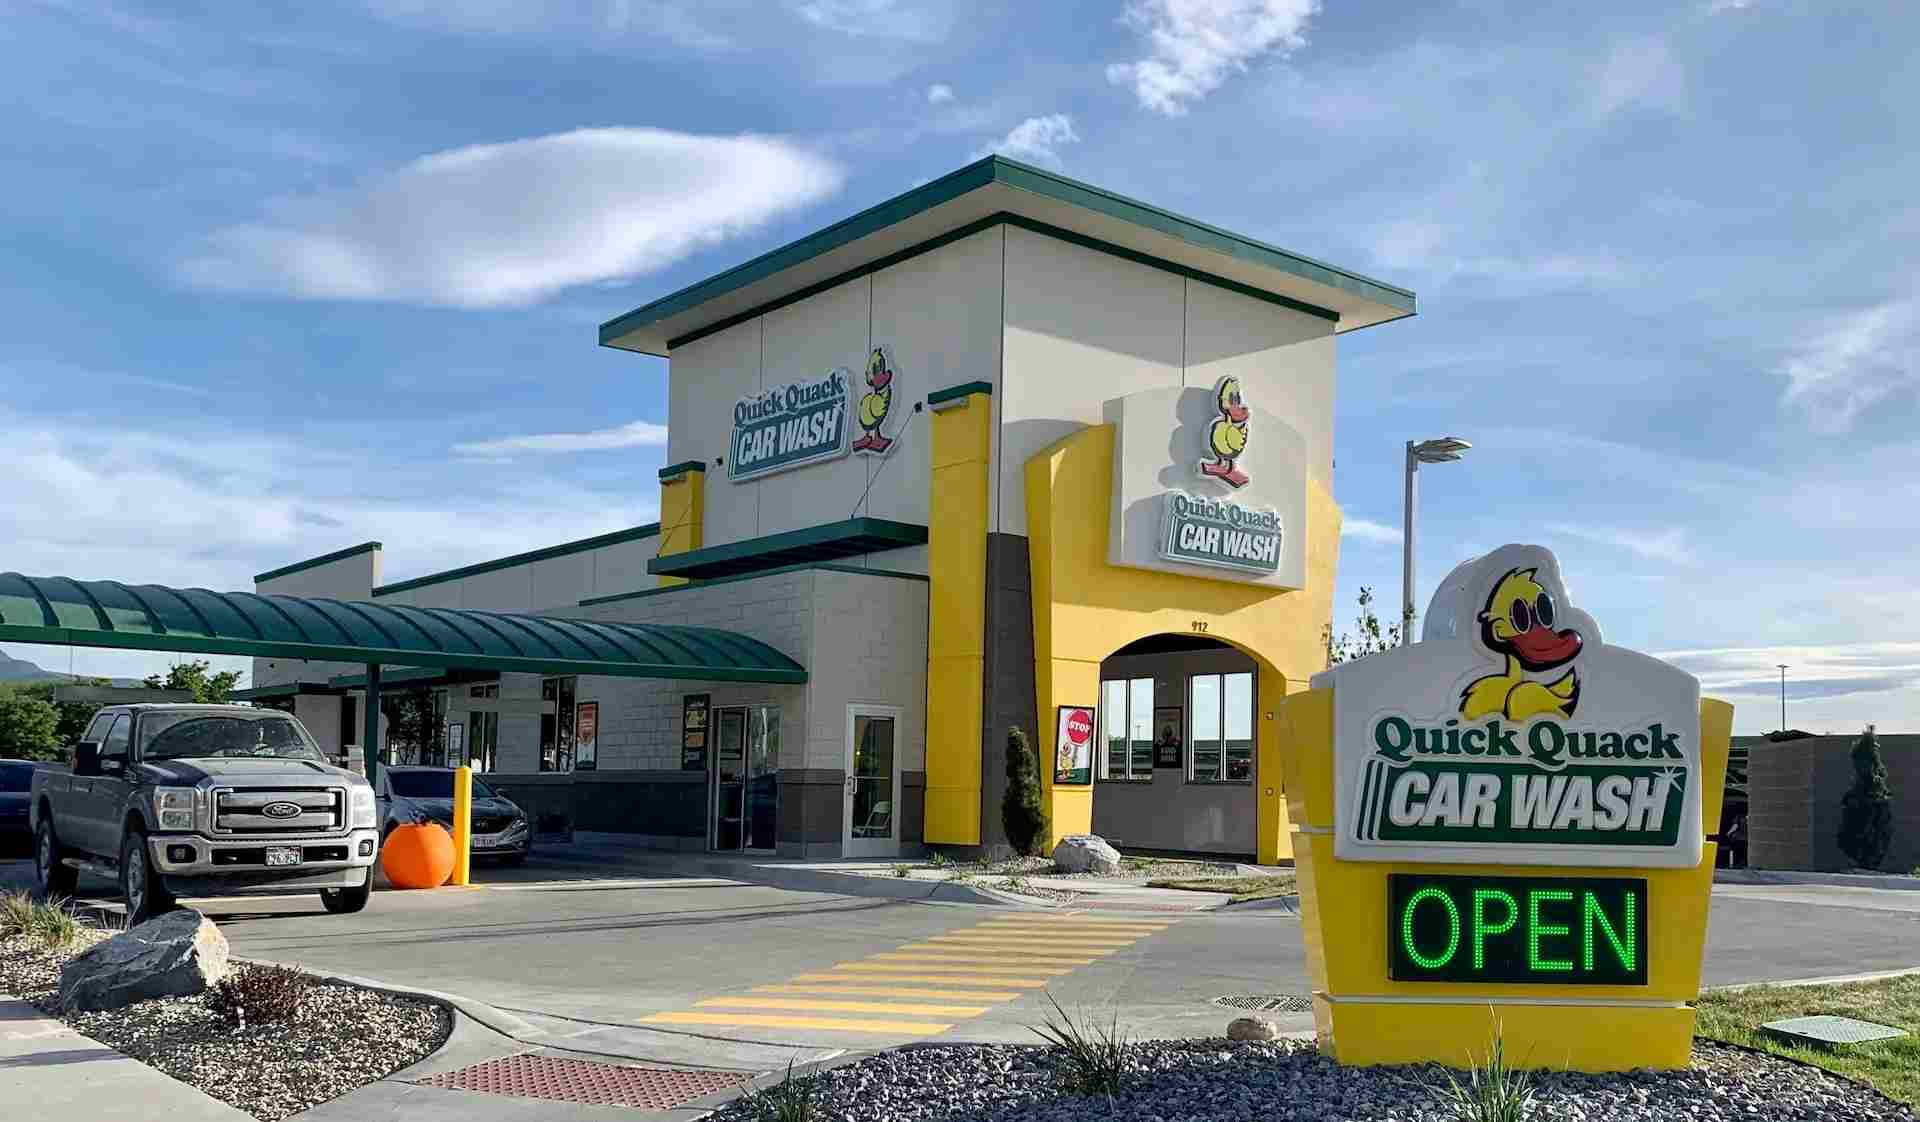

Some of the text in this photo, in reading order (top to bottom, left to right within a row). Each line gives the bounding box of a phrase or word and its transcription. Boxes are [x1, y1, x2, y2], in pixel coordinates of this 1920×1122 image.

[735, 372, 845, 426] Quick Quack
[738, 407, 839, 465] CAR WASH
[1174, 495, 1281, 528] Quick Quack
[1180, 523, 1279, 562] CAR WASH
[1191, 620, 1209, 632] 912
[1068, 720, 1090, 733] STOP
[1374, 716, 1685, 766] Quick Quack
[1388, 770, 1672, 832] CAR WASH
[1402, 887, 1636, 971] OPEN
